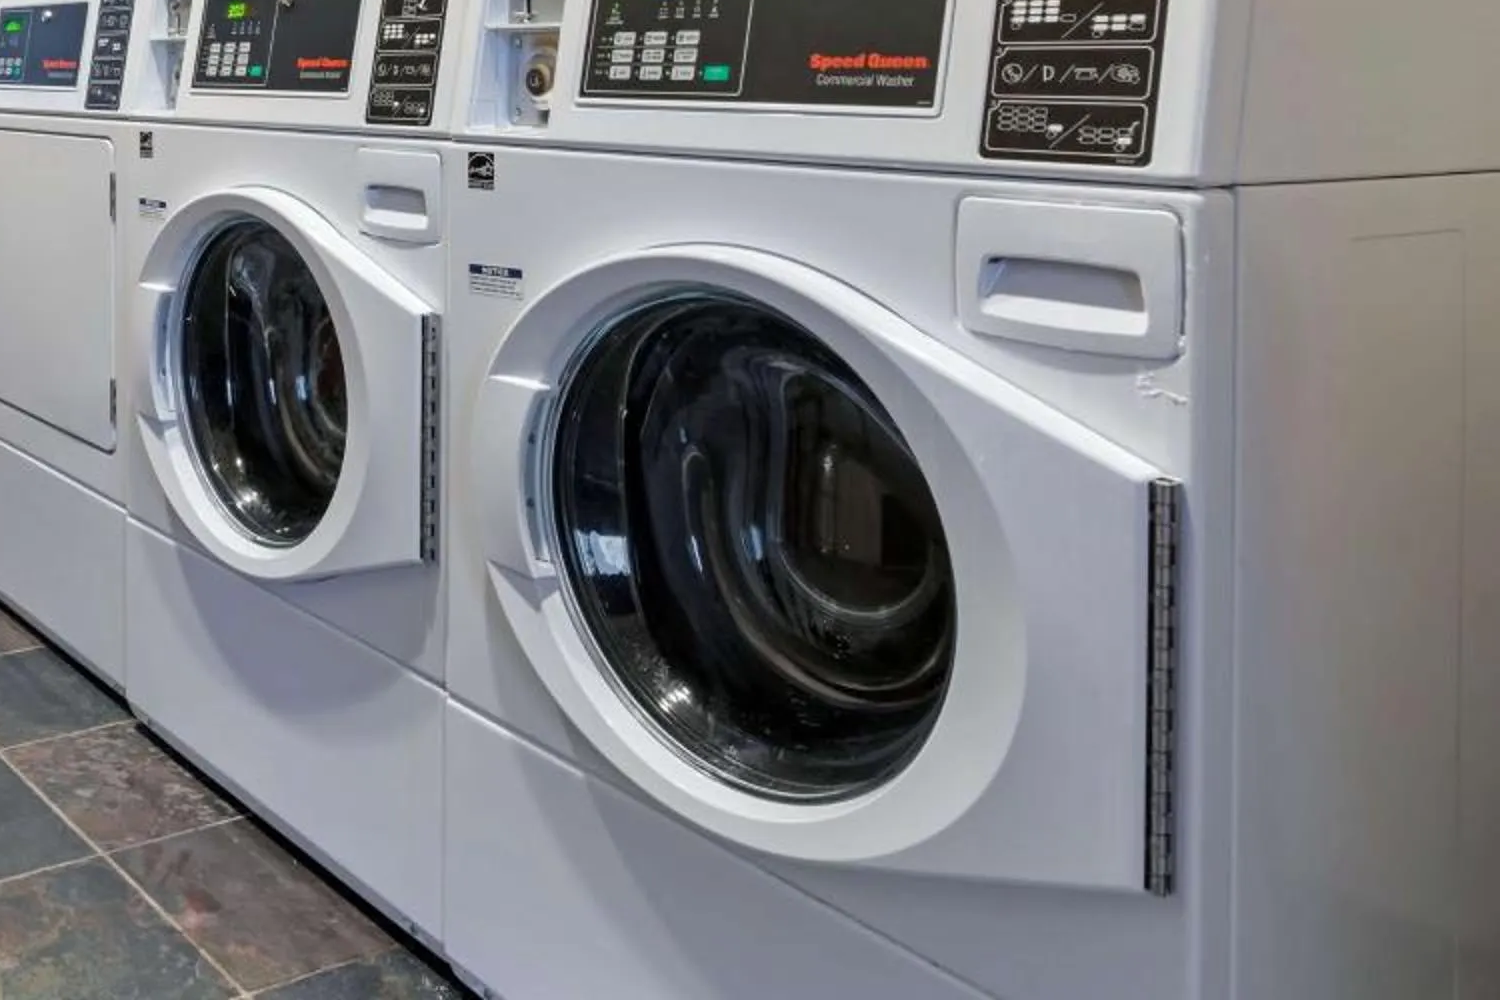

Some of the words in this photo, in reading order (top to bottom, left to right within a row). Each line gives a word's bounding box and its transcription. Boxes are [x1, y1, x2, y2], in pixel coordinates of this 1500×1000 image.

[810, 53, 866, 71] Speed
[868, 52, 928, 69] Queen
[816, 73, 874, 87] Commercial
[876, 73, 916, 87] Washer
